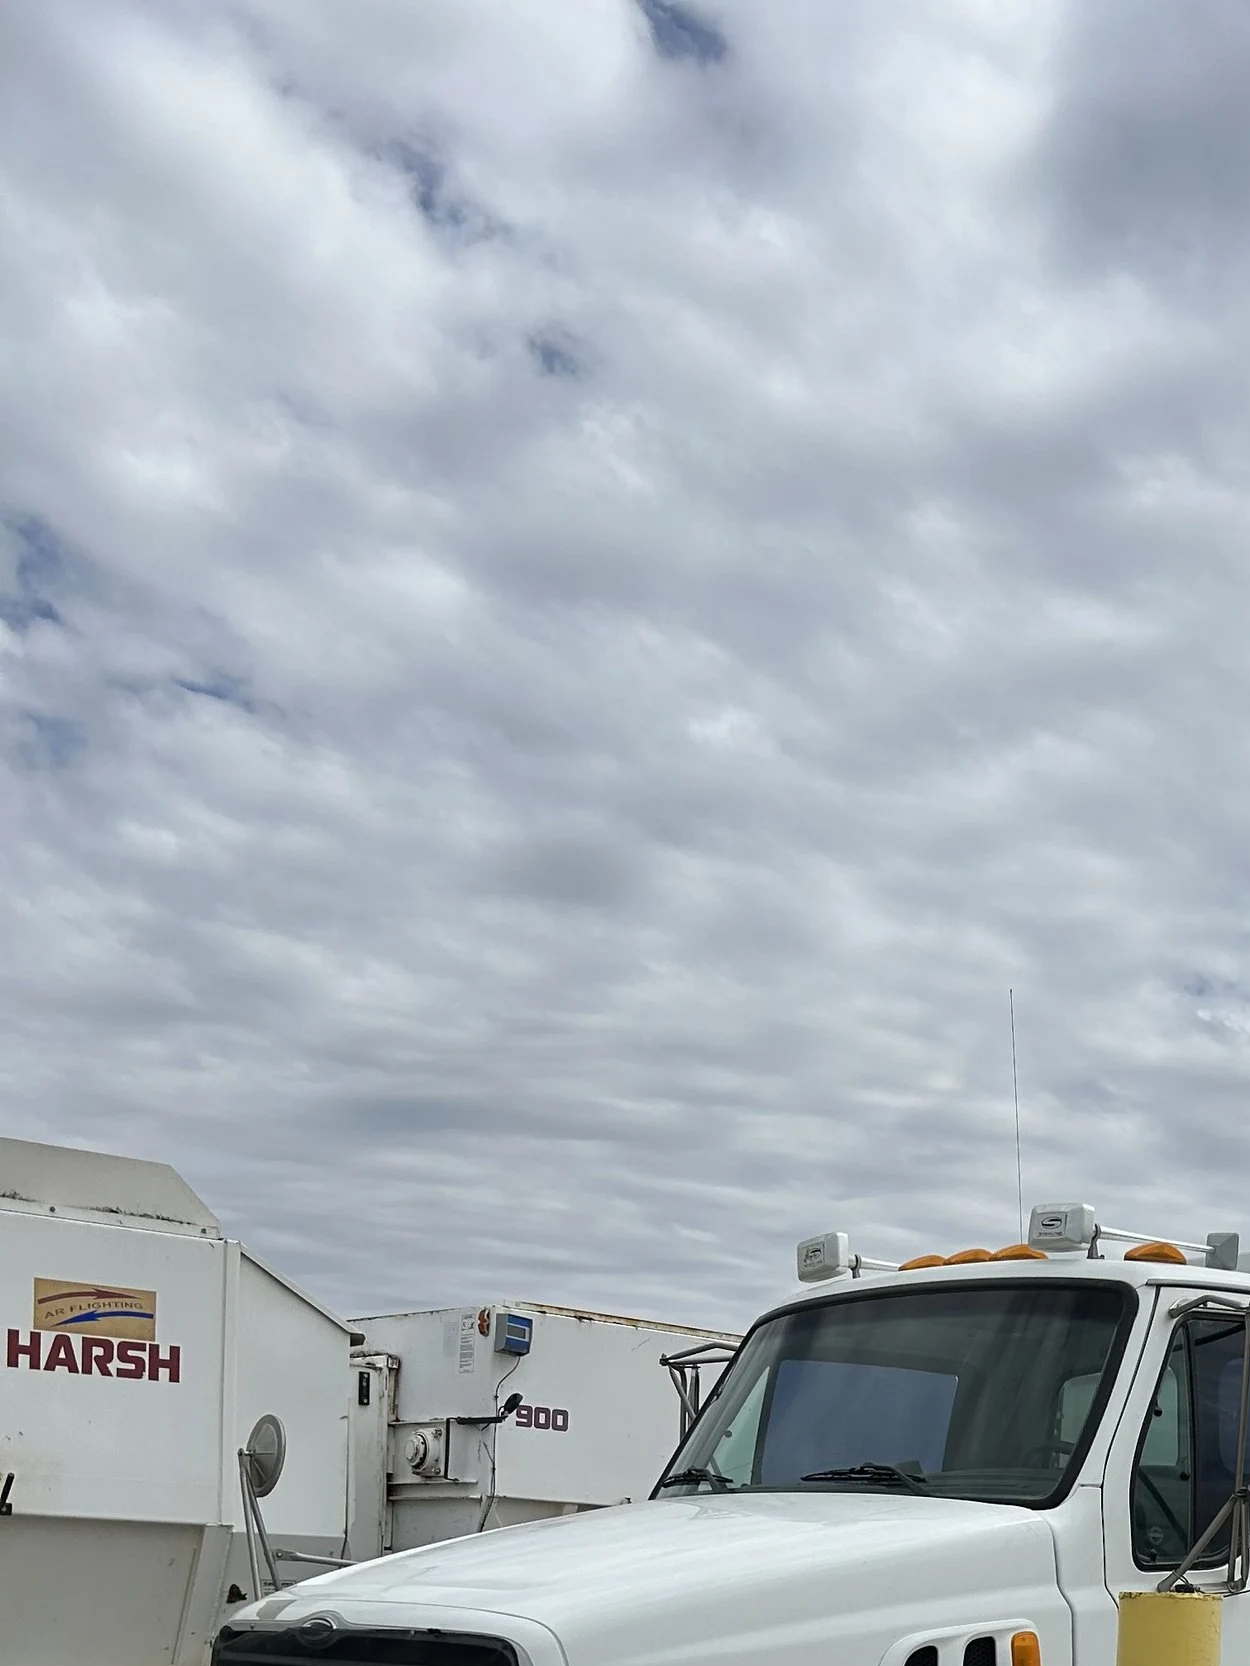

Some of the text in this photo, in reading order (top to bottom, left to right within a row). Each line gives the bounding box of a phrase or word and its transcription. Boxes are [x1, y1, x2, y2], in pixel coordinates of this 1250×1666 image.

[44, 1302, 144, 1319] AR FLIGHTING
[7, 1328, 181, 1384] HARSH
[515, 1404, 569, 1432] 900
